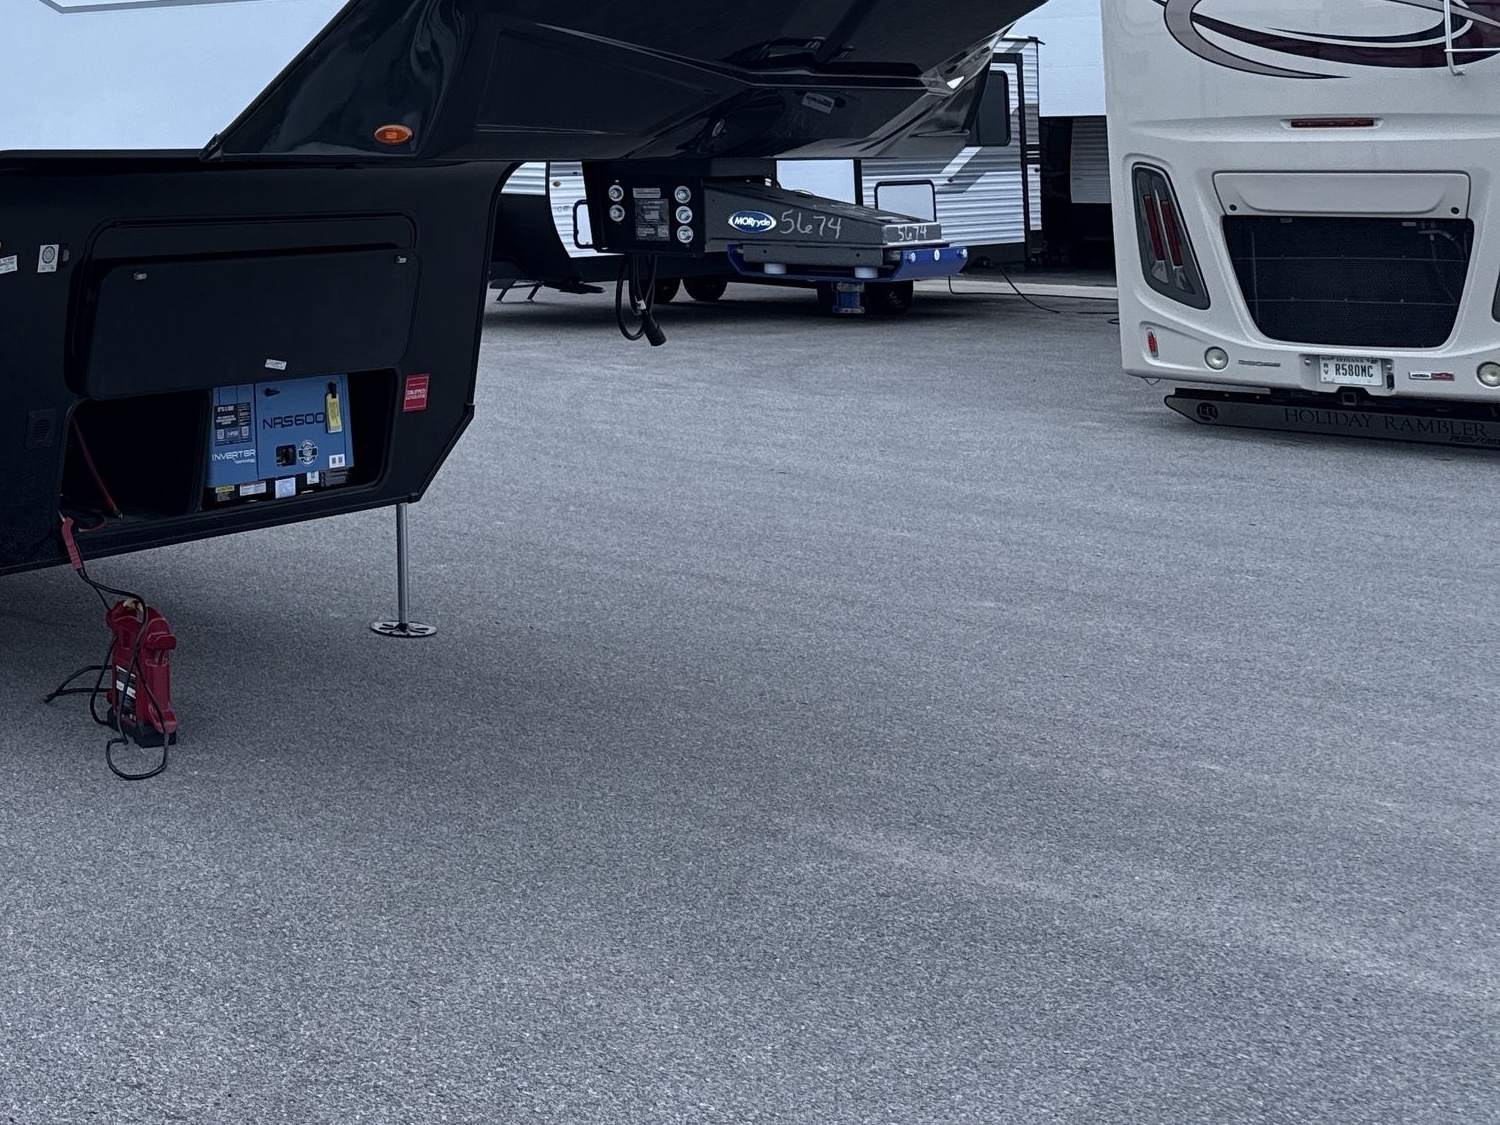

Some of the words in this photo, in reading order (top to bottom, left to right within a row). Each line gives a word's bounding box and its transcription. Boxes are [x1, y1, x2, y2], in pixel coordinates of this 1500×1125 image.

[733, 216, 772, 229] MORryde
[779, 209, 842, 239] 5674
[897, 225, 928, 242] 5674
[1284, 407, 1373, 429] HOLIDAY
[1384, 416, 1488, 438] RAMBLER
[212, 449, 256, 461] INVERTER
